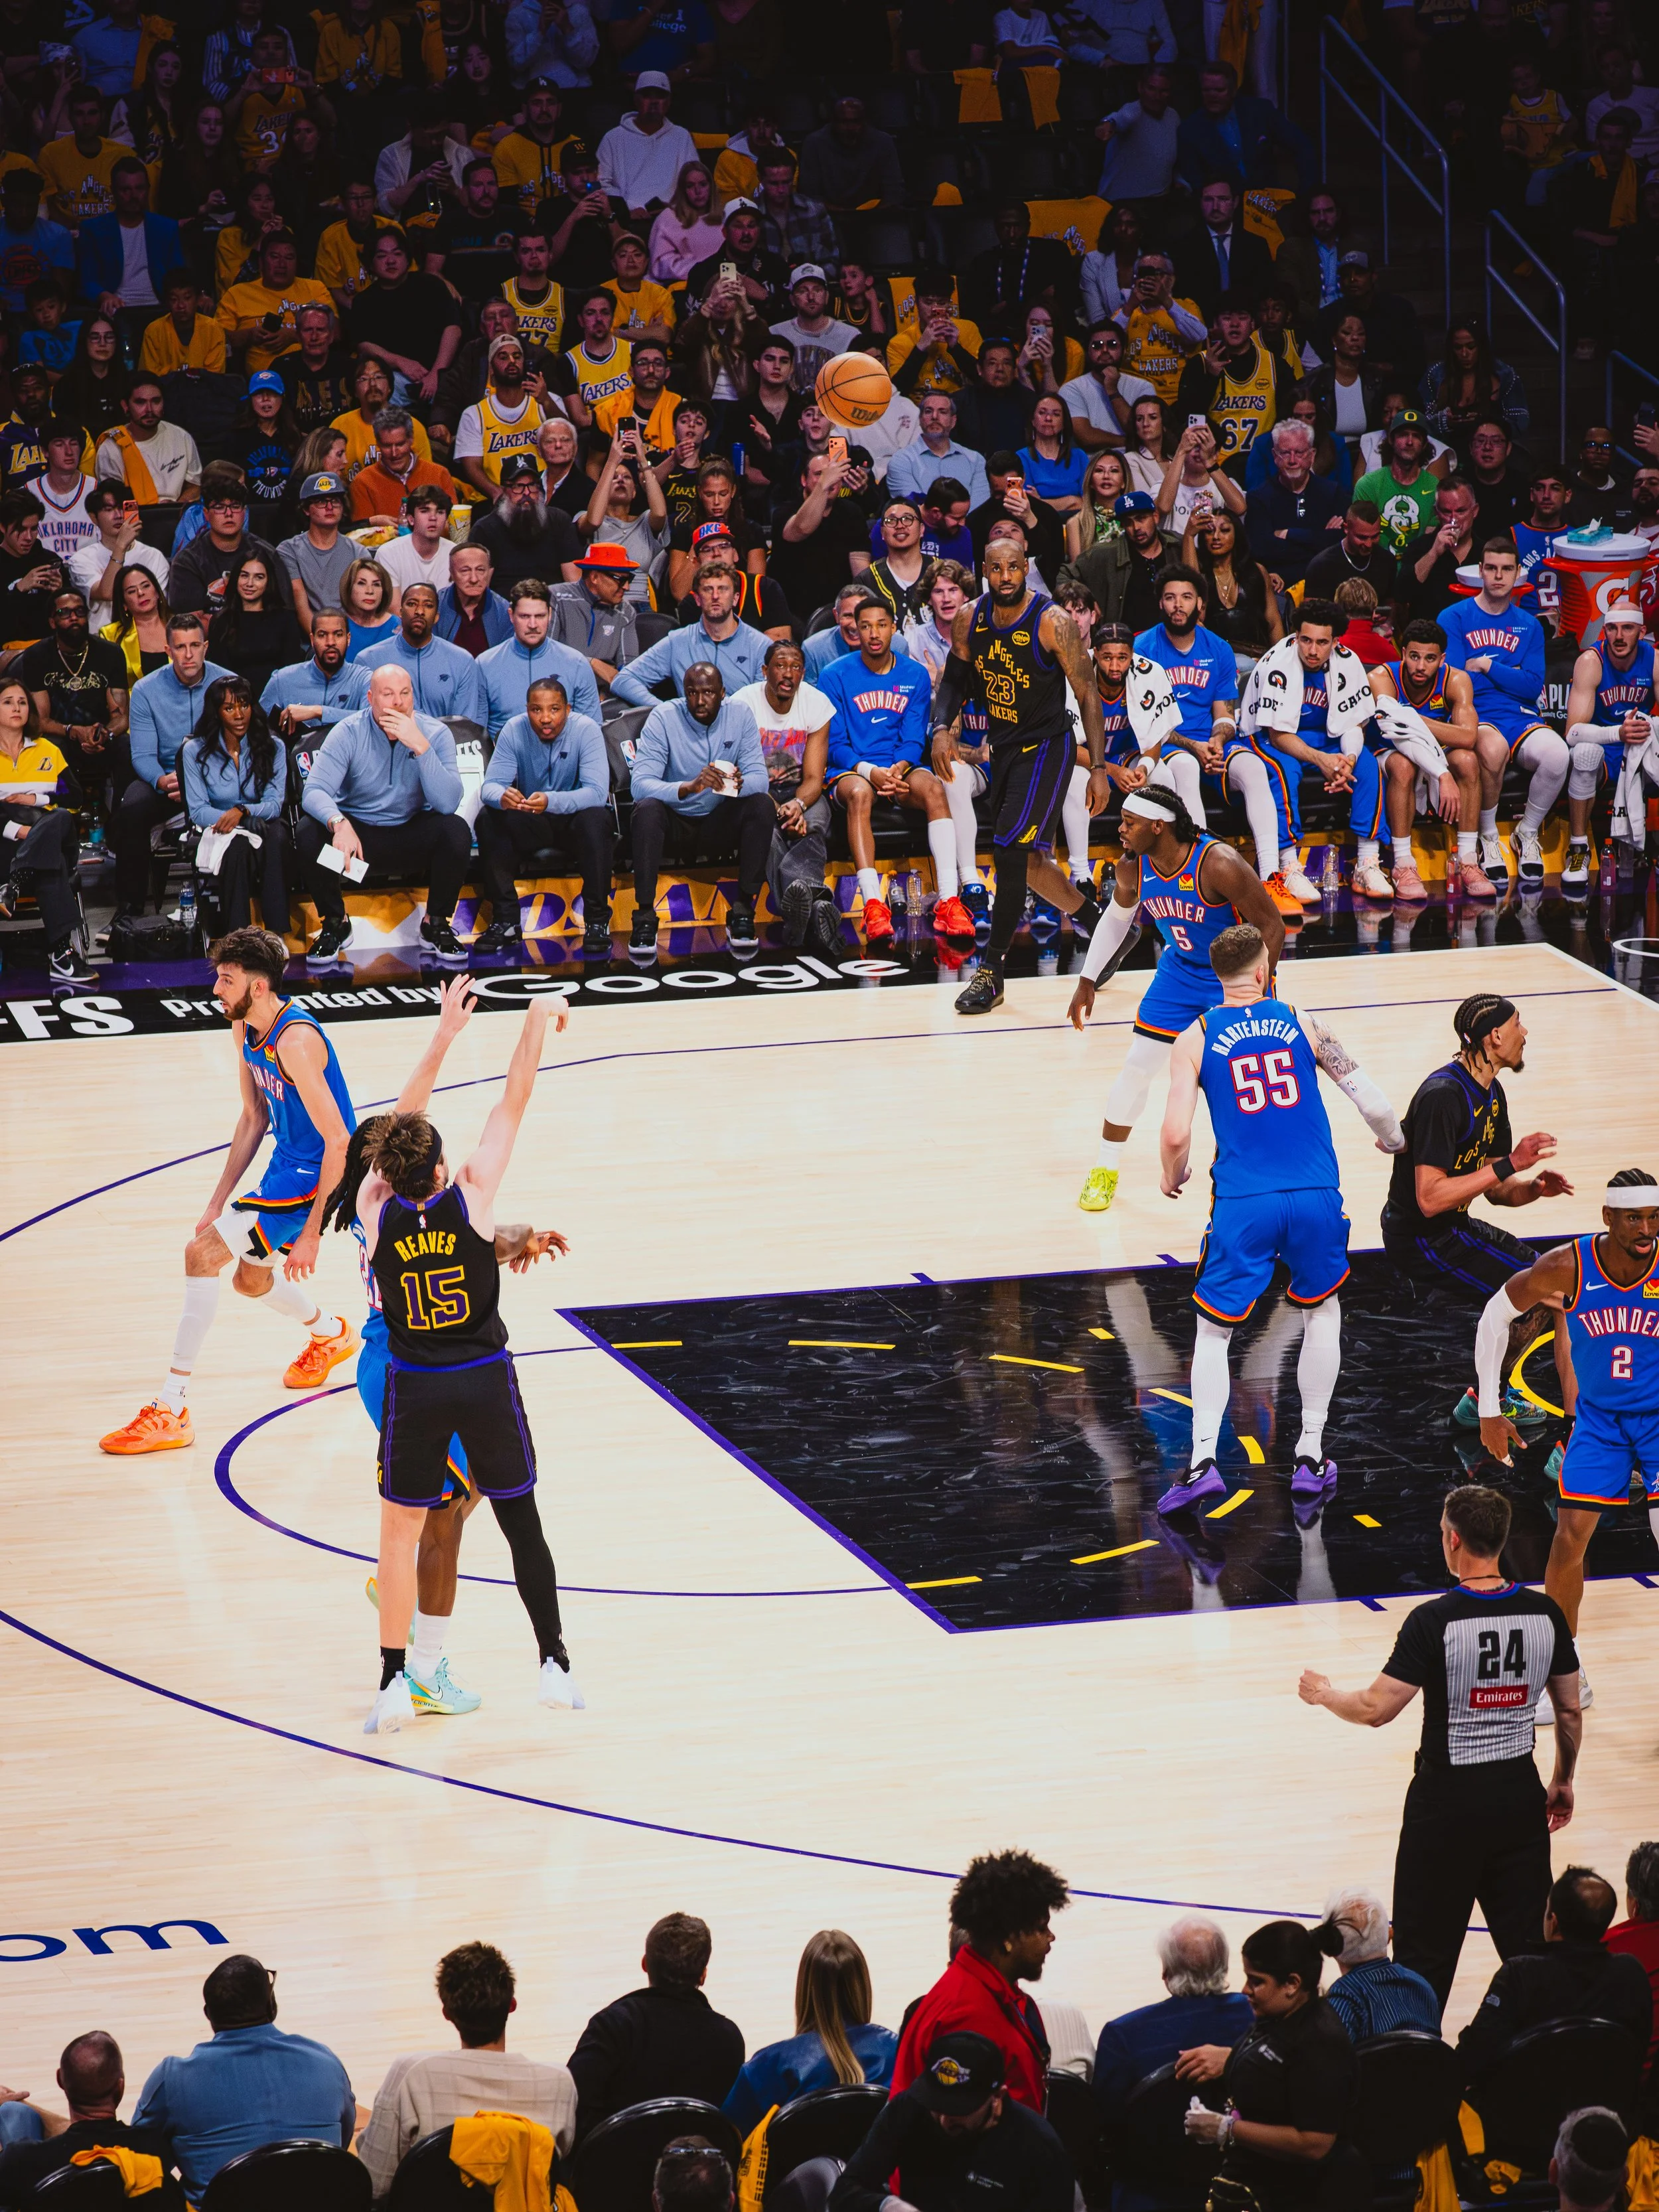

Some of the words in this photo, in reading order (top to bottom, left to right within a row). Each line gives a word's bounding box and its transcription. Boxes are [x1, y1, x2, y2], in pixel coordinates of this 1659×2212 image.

[253, 111, 295, 133] LAKE
[1138, 358, 1179, 372] LAKERS
[579, 373, 631, 403] LAKERS
[1211, 394, 1266, 411] LAKERS
[1404, 411, 1418, 422] O
[1220, 417, 1260, 452] 67
[53, 538, 79, 552] CITY
[699, 524, 722, 539] OKC
[1522, 547, 1556, 571] OUS-A
[1538, 570, 1559, 609] 2
[1465, 628, 1520, 654] THUNDER
[987, 639, 1030, 689] ANGELES
[1165, 666, 1211, 690] HUNDER
[852, 690, 909, 714] THUNDER
[982, 670, 1016, 706] 23
[1337, 684, 1372, 713] GATO
[1599, 684, 1649, 707] THUNDER
[987, 700, 1019, 724] LAKERS
[1142, 896, 1206, 924] THUNDER
[1169, 924, 1194, 952] 5
[0, 995, 134, 1039] FS
[387, 986, 442, 1004] by
[469, 956, 910, 998] Google
[1211, 1019, 1300, 1057] HARTENSTEIN
[1228, 1048, 1301, 1115] 55
[1454, 1140, 1480, 1170] LOS
[394, 1231, 457, 1262] REAVES
[400, 1264, 470, 1331] 15
[1611, 1345, 1634, 1380] 2
[1478, 1629, 1527, 1680] 24
[1477, 1691, 1523, 1704] Emirates
[0, 1919, 230, 1962] om
